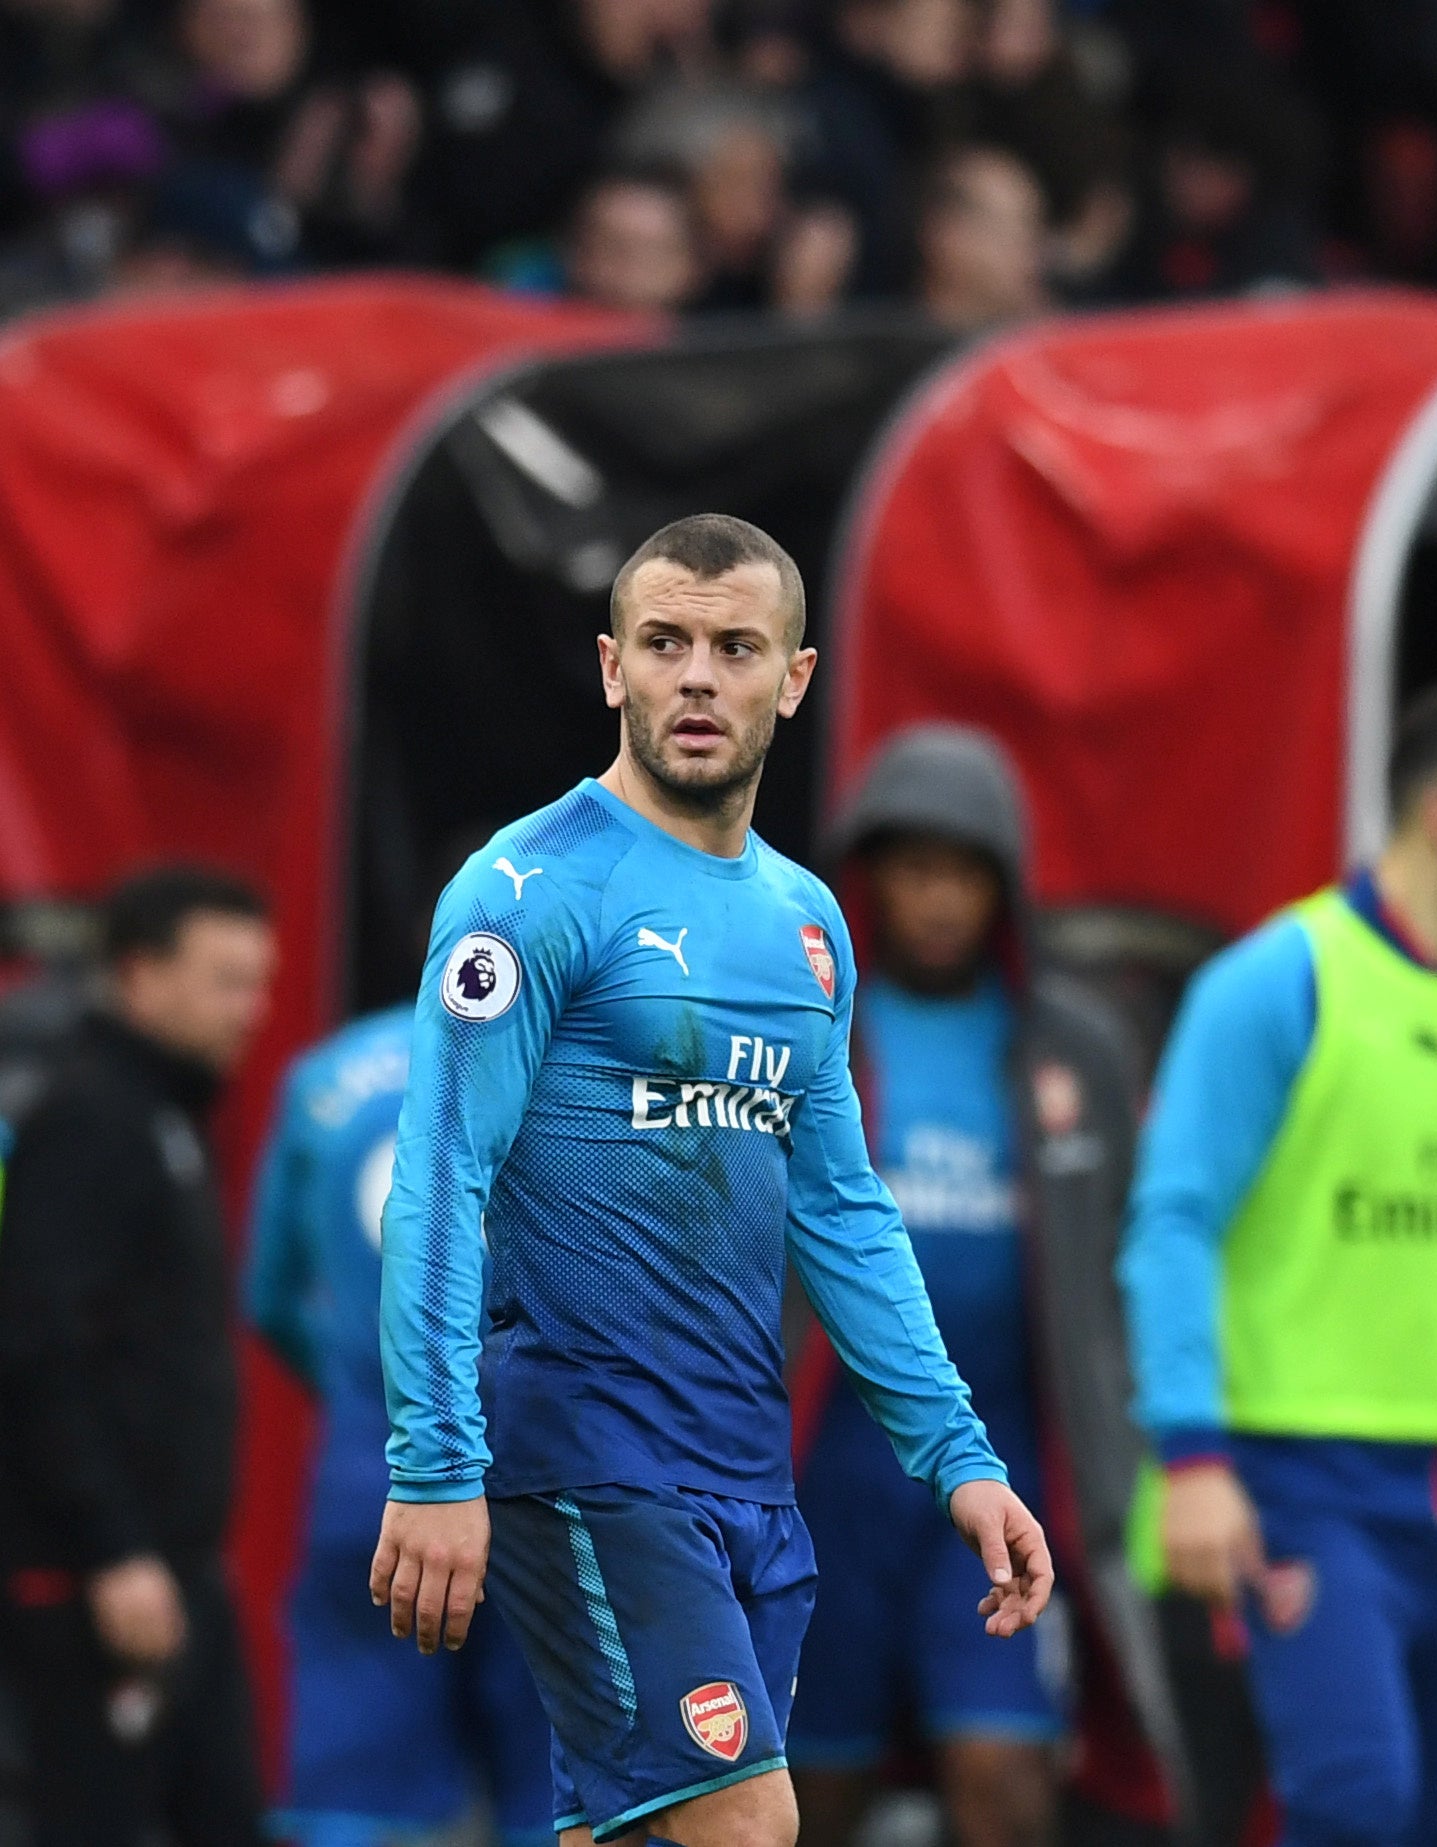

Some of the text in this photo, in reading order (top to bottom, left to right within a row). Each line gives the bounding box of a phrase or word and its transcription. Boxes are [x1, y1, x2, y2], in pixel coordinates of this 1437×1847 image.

[727, 1035, 790, 1088] Fly
[631, 1077, 796, 1136] Emira
[691, 1691, 736, 1716] Arsenal
